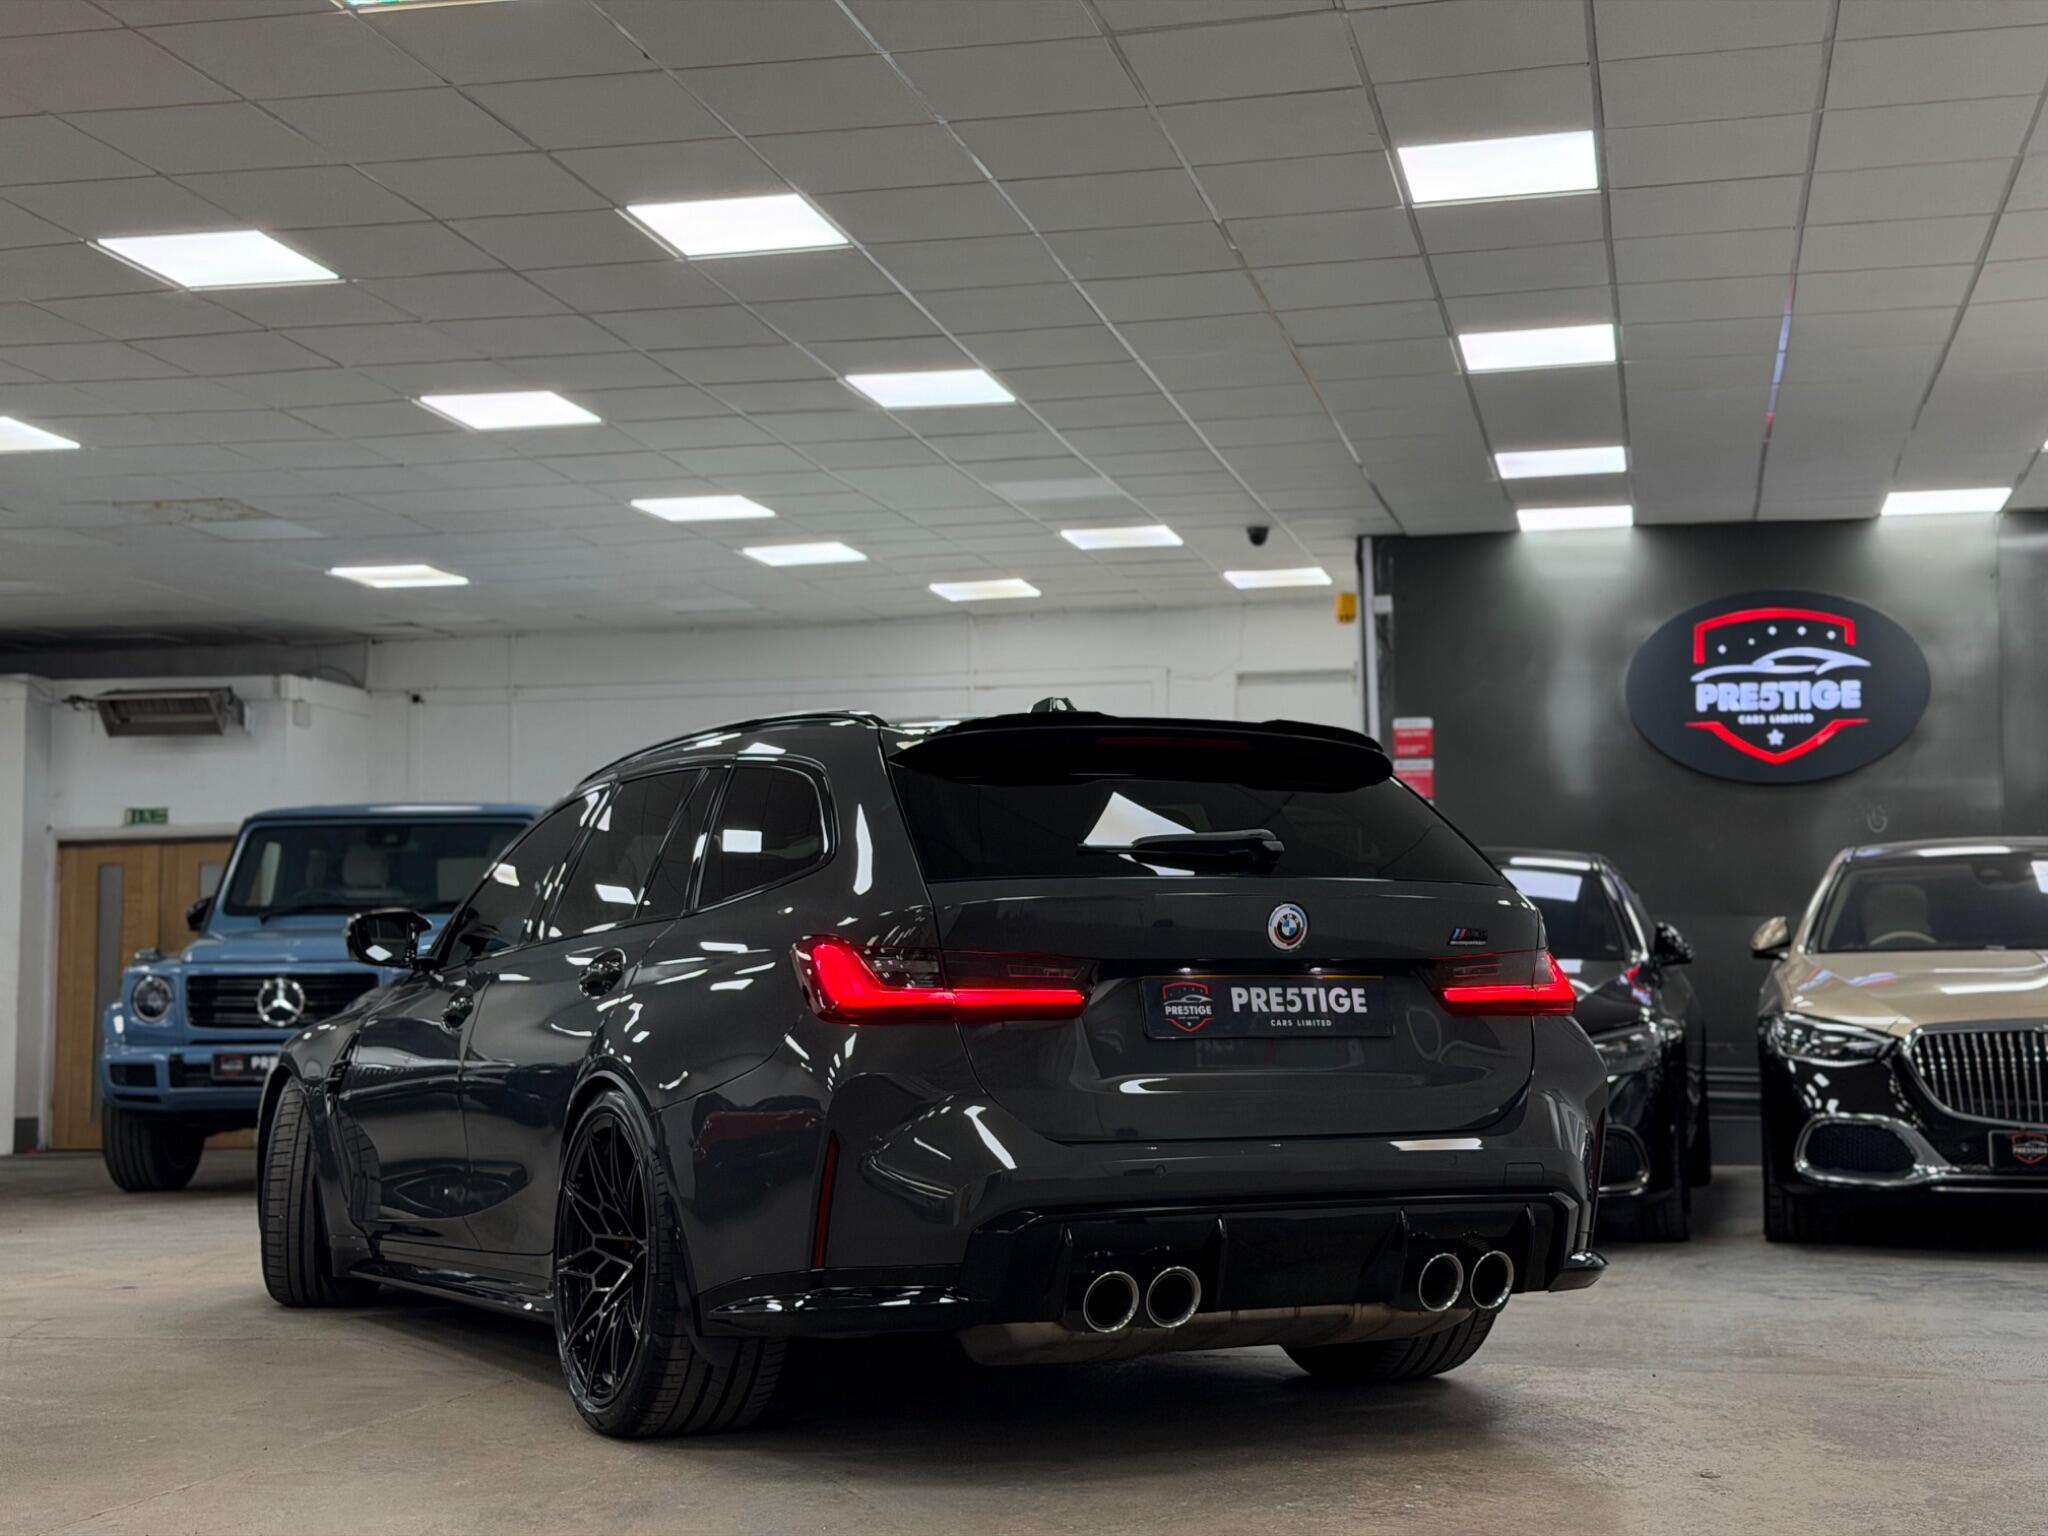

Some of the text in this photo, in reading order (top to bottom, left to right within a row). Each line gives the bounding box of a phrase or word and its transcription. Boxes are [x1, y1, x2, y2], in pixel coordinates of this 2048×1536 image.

[1231, 987, 1368, 1013] PRE5TIGE
[1270, 1019, 1332, 1027] CARS LIMITED
